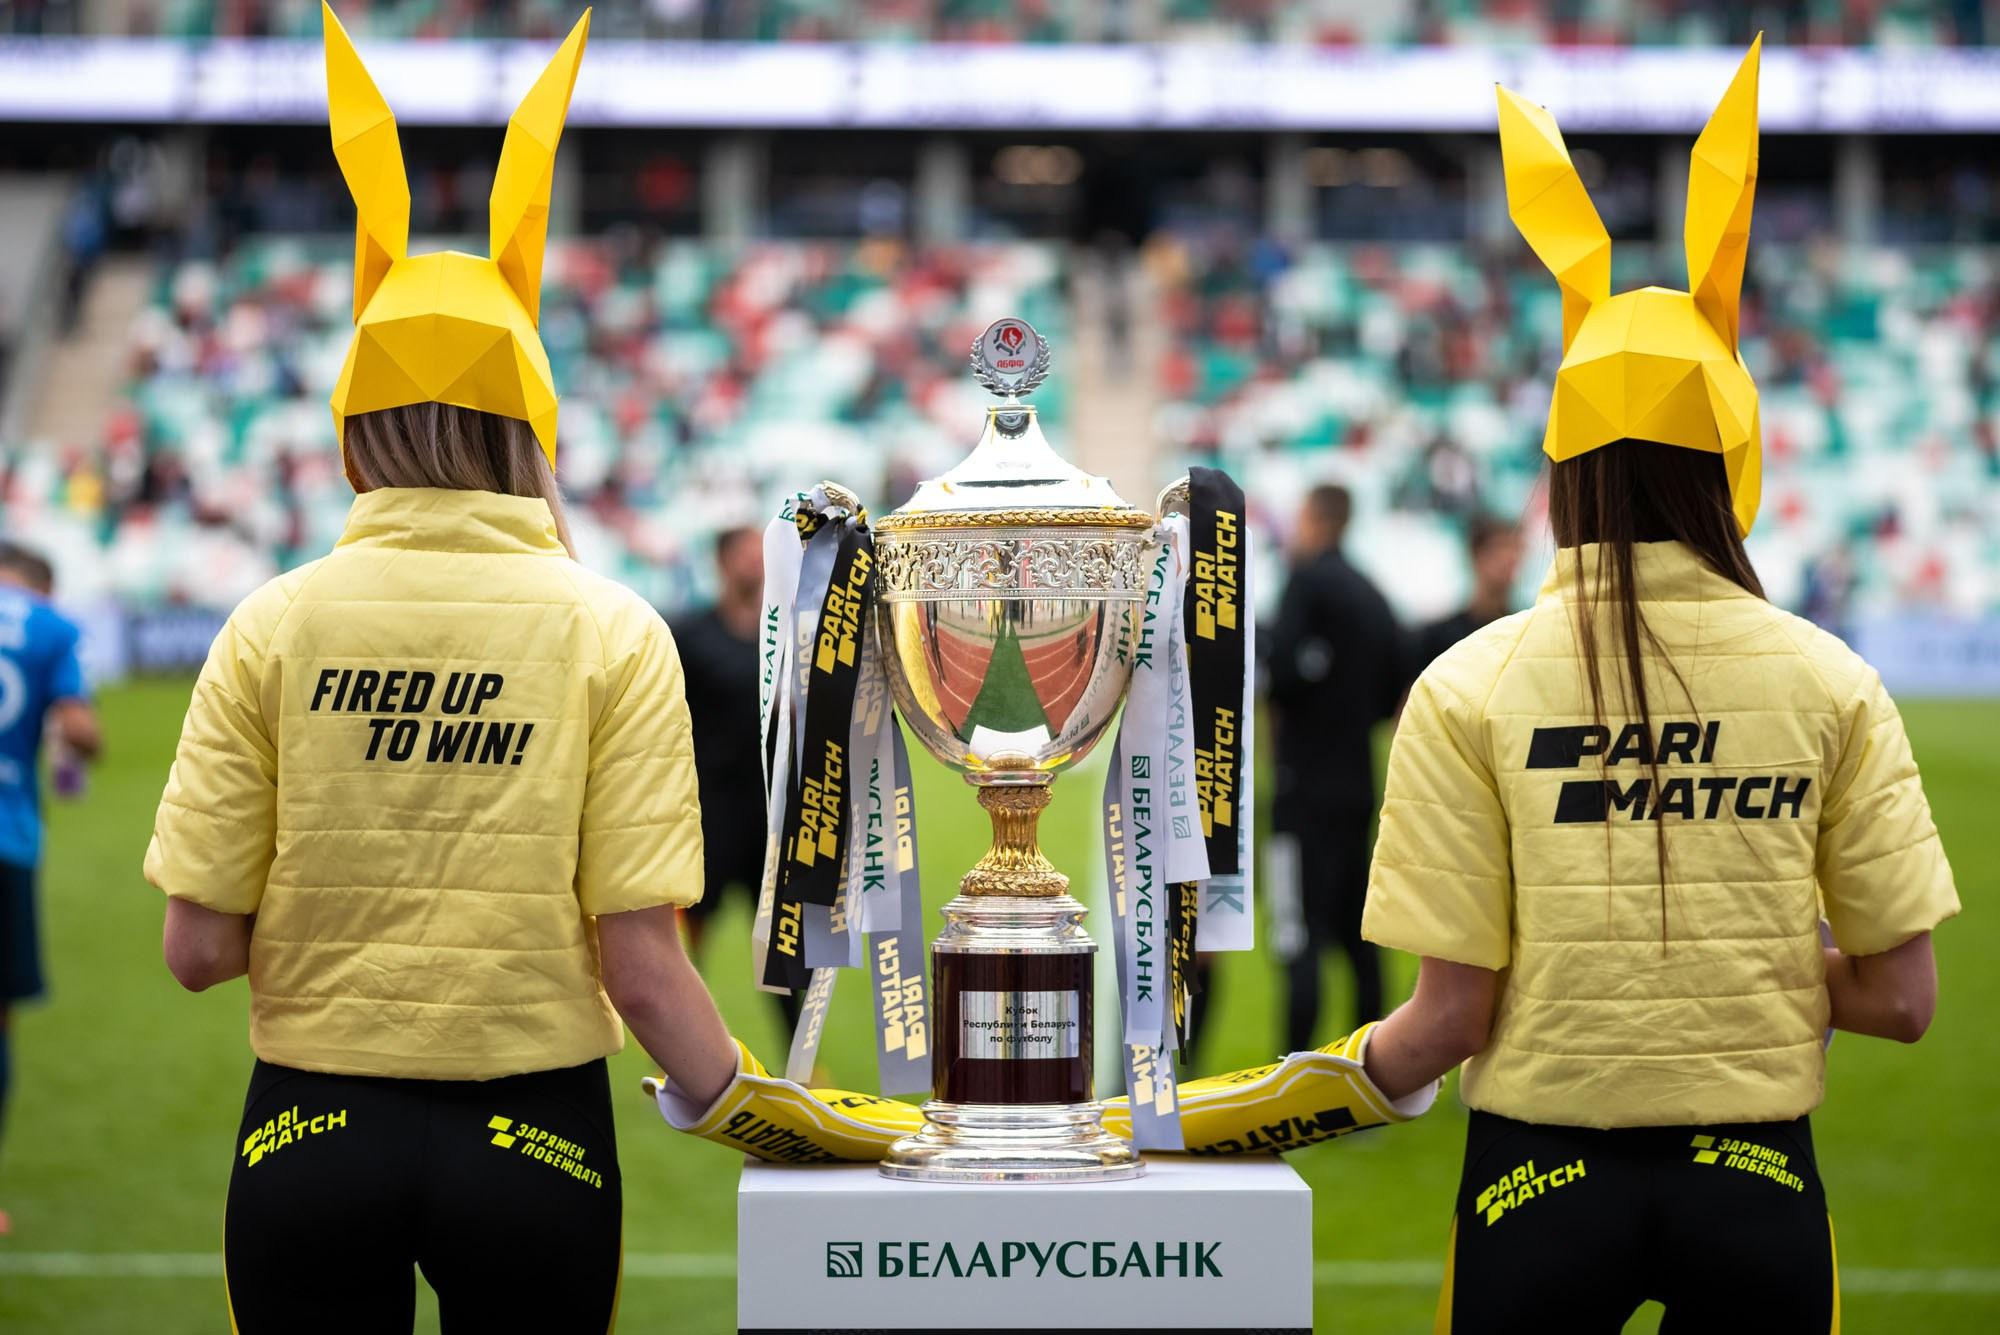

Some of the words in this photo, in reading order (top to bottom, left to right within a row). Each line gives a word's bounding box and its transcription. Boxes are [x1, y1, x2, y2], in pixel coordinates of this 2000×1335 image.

[1195, 550, 1216, 641] PARI
[1216, 509, 1237, 630] MATCH
[816, 583, 846, 675] PARI
[837, 547, 874, 668] MATCH
[310, 669, 436, 713] FIRED
[441, 672, 504, 715] UP
[365, 718, 420, 761] TO
[426, 720, 535, 765] WIN!
[1213, 706, 1235, 827] MATCH
[1525, 720, 1721, 769] PARI
[796, 776, 822, 868] PARI
[817, 739, 843, 861] MATCH
[1553, 776, 1812, 823] MATCH
[1132, 787, 1152, 1003] БЕЛАРУСБАНК
[1006, 1006, 1038, 1016] Кубок
[1031, 1020, 1076, 1029] Беларусь
[242, 1105, 298, 1157] PARI
[248, 1109, 347, 1167] MATCH
[515, 1123, 586, 1161] ЗАРЯЖЕН
[1718, 1138, 1789, 1168] ЗАРЯЖЕН
[521, 1142, 602, 1188] ПОБЕЖДАТЬ
[1476, 1160, 1536, 1215] PARI
[1724, 1154, 1804, 1193] ПОБЕЖДАТЬ
[1487, 1159, 1586, 1227] MATCH
[878, 1240, 1224, 1278] БЕЛАРУСБАНК
